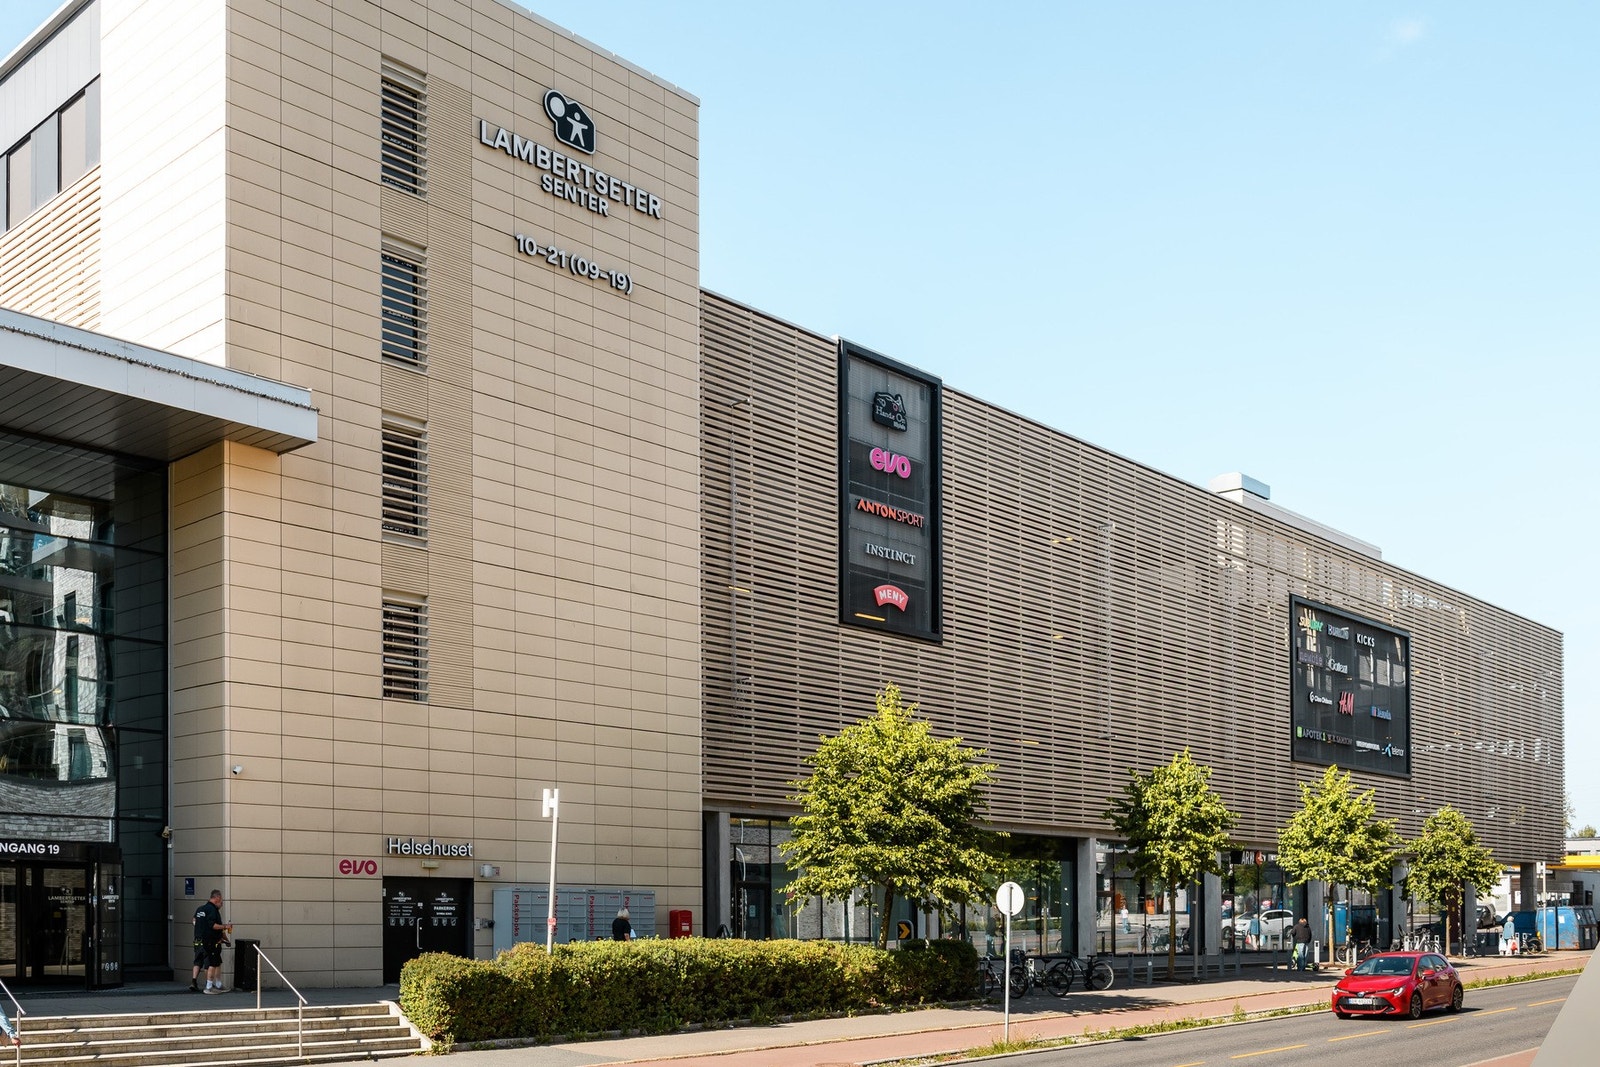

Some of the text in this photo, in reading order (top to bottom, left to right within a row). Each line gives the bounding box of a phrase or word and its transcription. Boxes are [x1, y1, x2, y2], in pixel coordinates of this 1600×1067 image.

[480, 119, 662, 220] LAMBERTSETER
[541, 175, 609, 217] SENTER
[514, 233, 633, 296] 10-21 (09-19)
[869, 447, 911, 479] evo
[865, 543, 916, 565] INSTINCT
[879, 589, 905, 603] MENY
[1356, 633, 1375, 647] KICKS
[1303, 729, 1322, 740] APOTEK
[47, 844, 60, 854] 19
[387, 837, 473, 857] Helsehuset
[338, 859, 378, 876] evo
